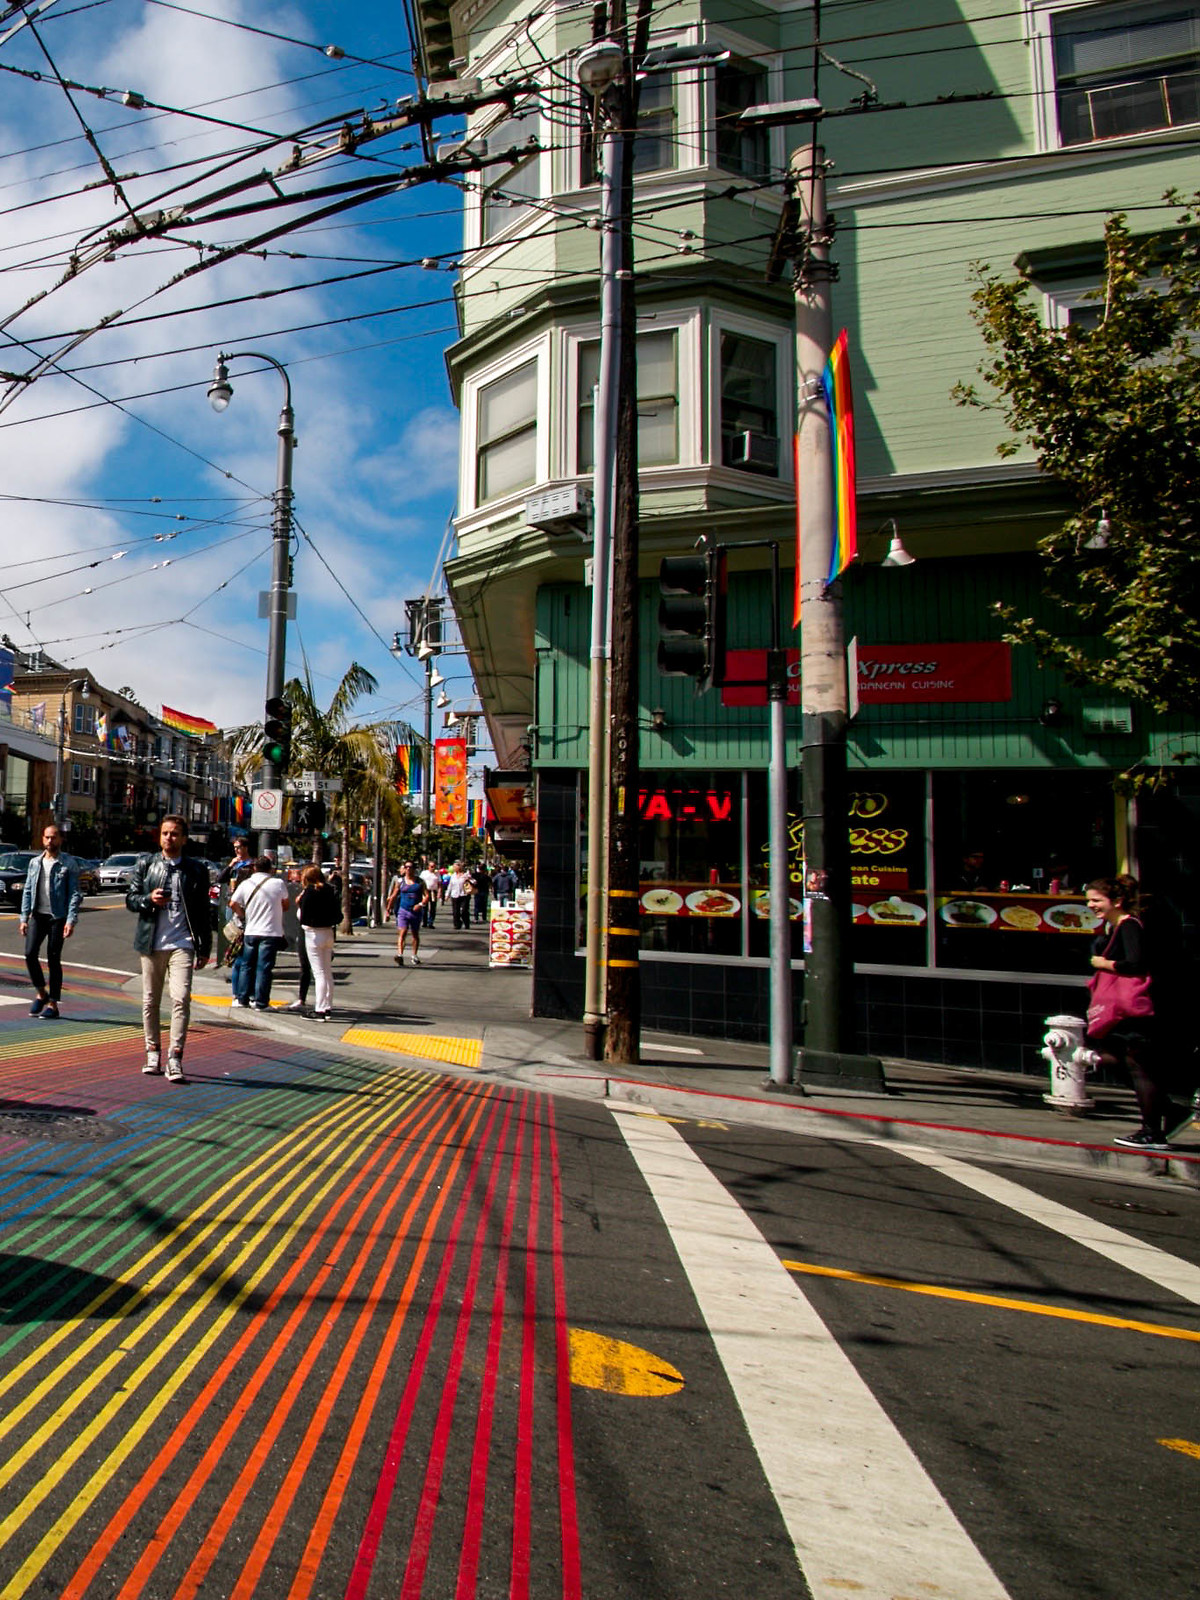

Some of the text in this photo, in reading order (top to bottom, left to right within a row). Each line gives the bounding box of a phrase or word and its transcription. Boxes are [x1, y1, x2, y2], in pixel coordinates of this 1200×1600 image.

[858, 659, 938, 679] Xpress
[912, 680, 955, 689] CUISINE
[293, 780, 328, 789] 18th St
[870, 865, 908, 873] Cuisine
